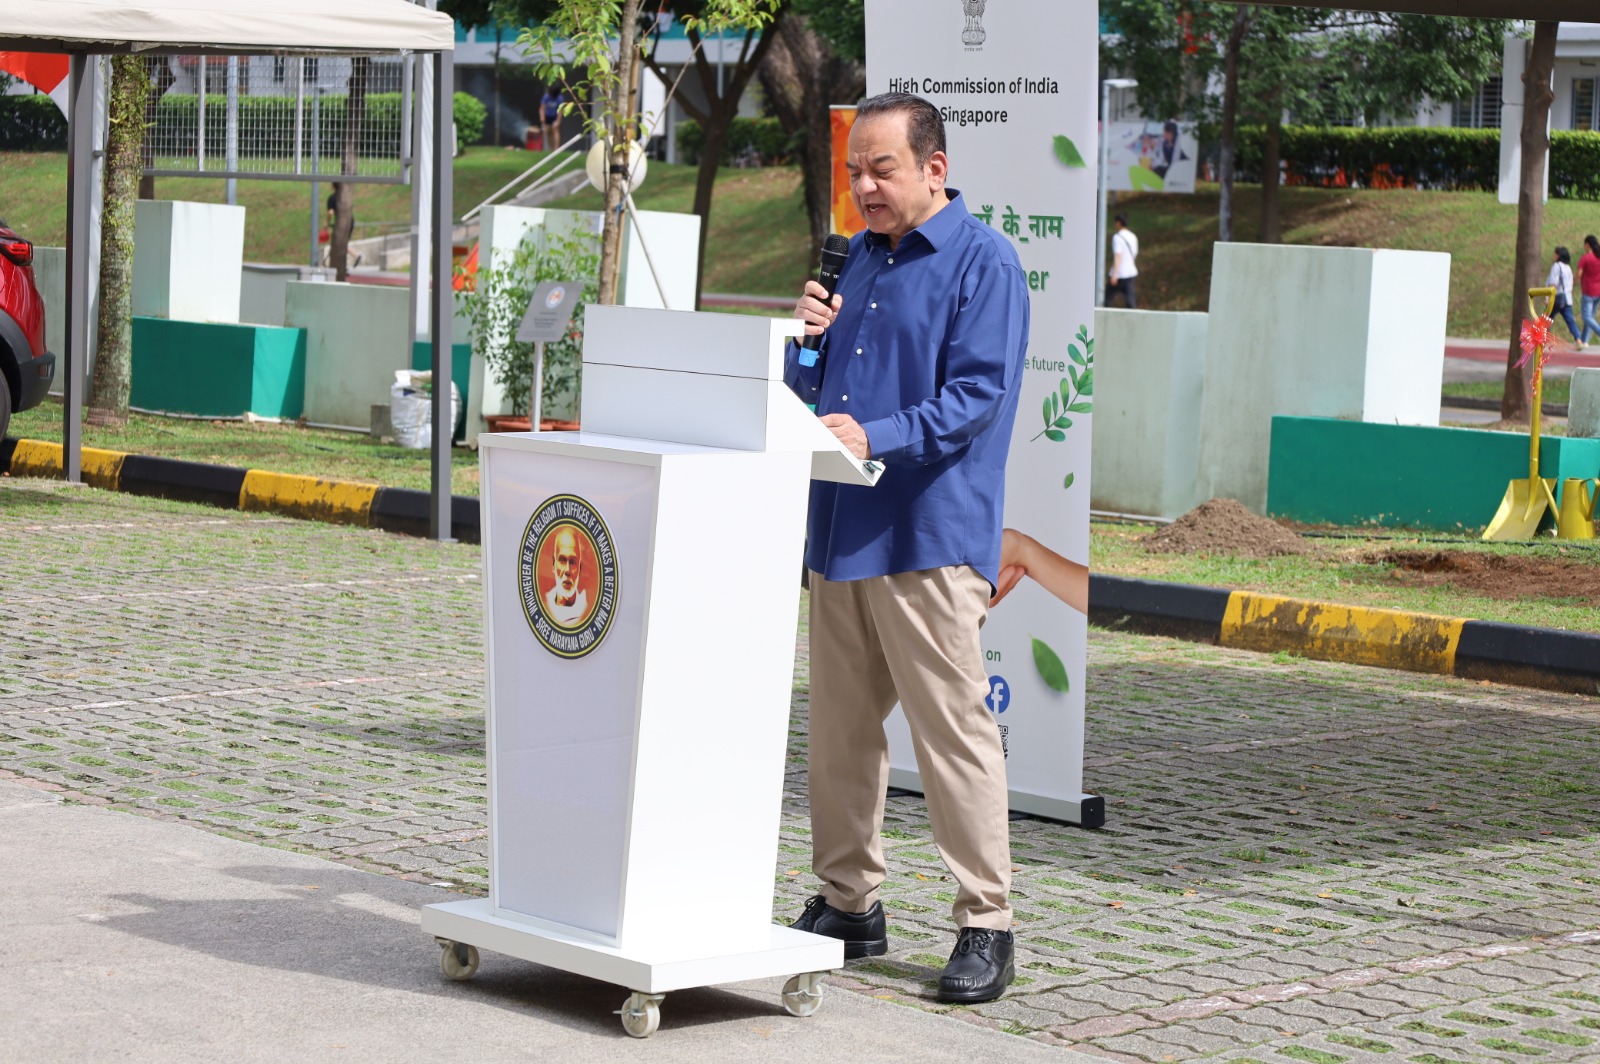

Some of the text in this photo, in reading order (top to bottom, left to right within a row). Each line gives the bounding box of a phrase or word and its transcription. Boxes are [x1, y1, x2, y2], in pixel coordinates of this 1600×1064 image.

[889, 77, 1059, 94] High Commission of India
[940, 106, 1008, 127] Singapore
[1023, 269, 1049, 291] er
[1032, 356, 1066, 372] future
[532, 503, 557, 536] RELIGION
[556, 501, 562, 517] IT
[563, 501, 590, 524] SUFFICES
[587, 515, 597, 529] IF
[592, 523, 602, 536] IT
[525, 530, 538, 550] THE
[596, 532, 613, 565] MAKES
[523, 549, 534, 563] BE
[522, 564, 539, 616] WHICHEVER
[601, 576, 614, 610] BETTER
[594, 607, 609, 631] MAN
[535, 617, 595, 652] SREE NARAYANA GURU
[986, 649, 1001, 662] on
